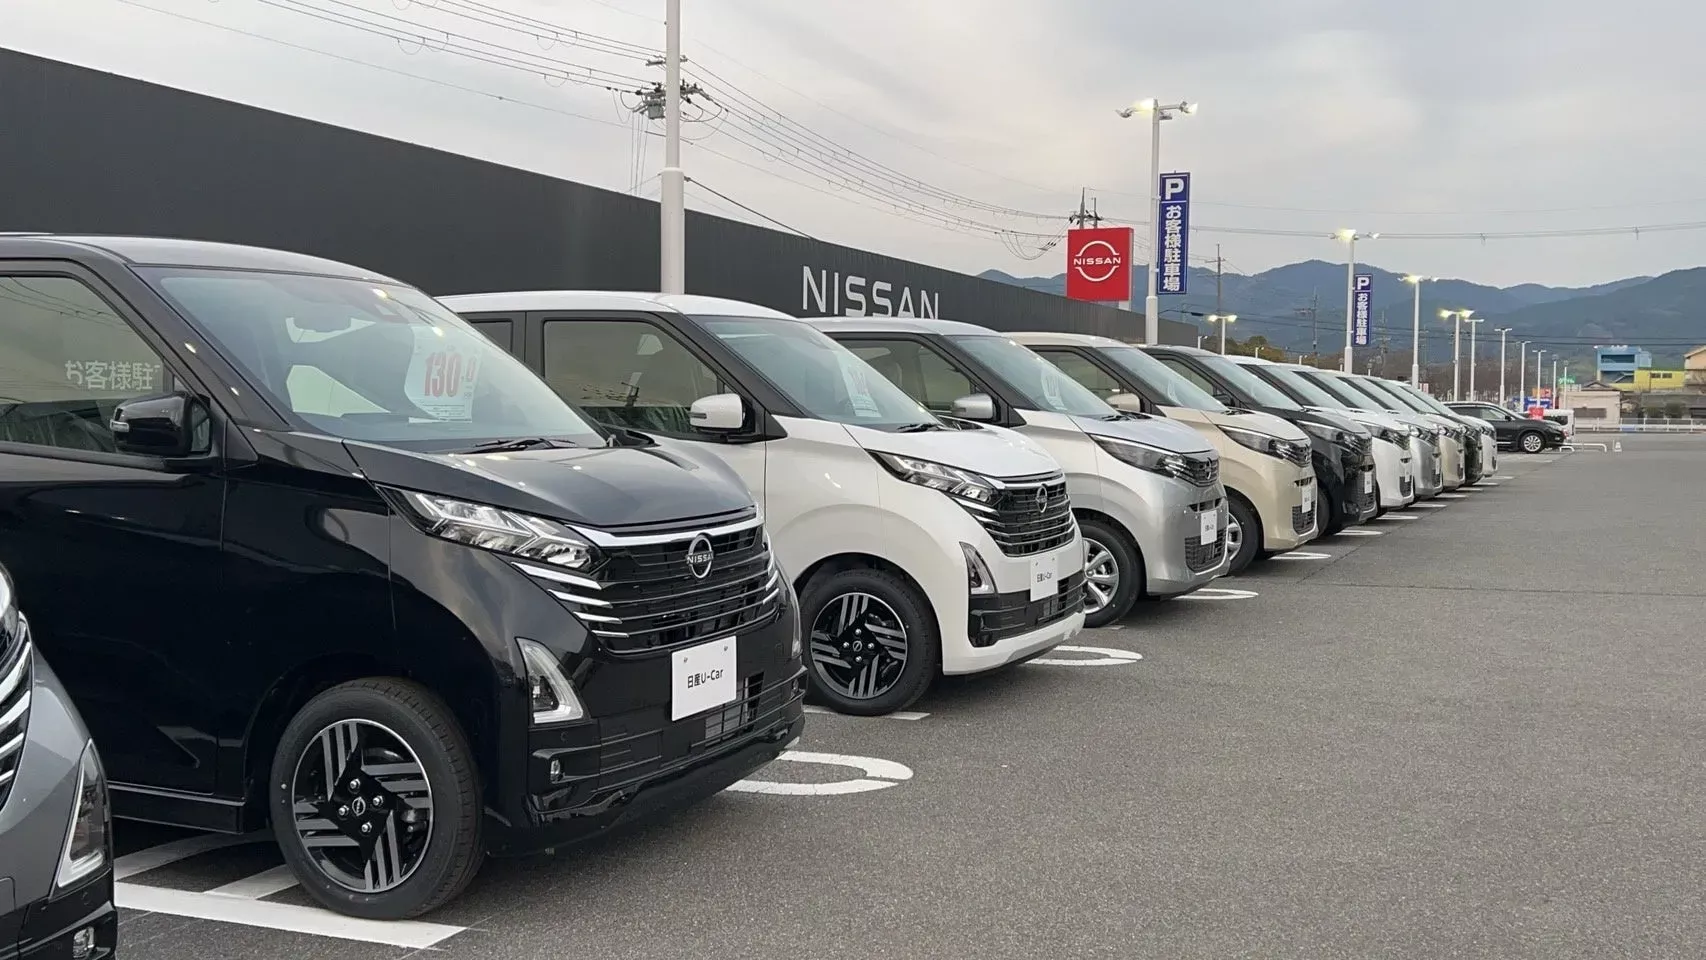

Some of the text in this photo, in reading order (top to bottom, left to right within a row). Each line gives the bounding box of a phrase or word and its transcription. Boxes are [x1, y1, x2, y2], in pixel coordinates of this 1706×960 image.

[1165, 178, 1185, 200] P
[1163, 205, 1182, 291] お客様駐車場
[1073, 257, 1121, 265] NISSAN
[802, 265, 939, 319] NISSAN
[1357, 277, 1370, 290] P
[64, 359, 161, 390] お客様駐
[687, 668, 724, 688] 日産U-Car
